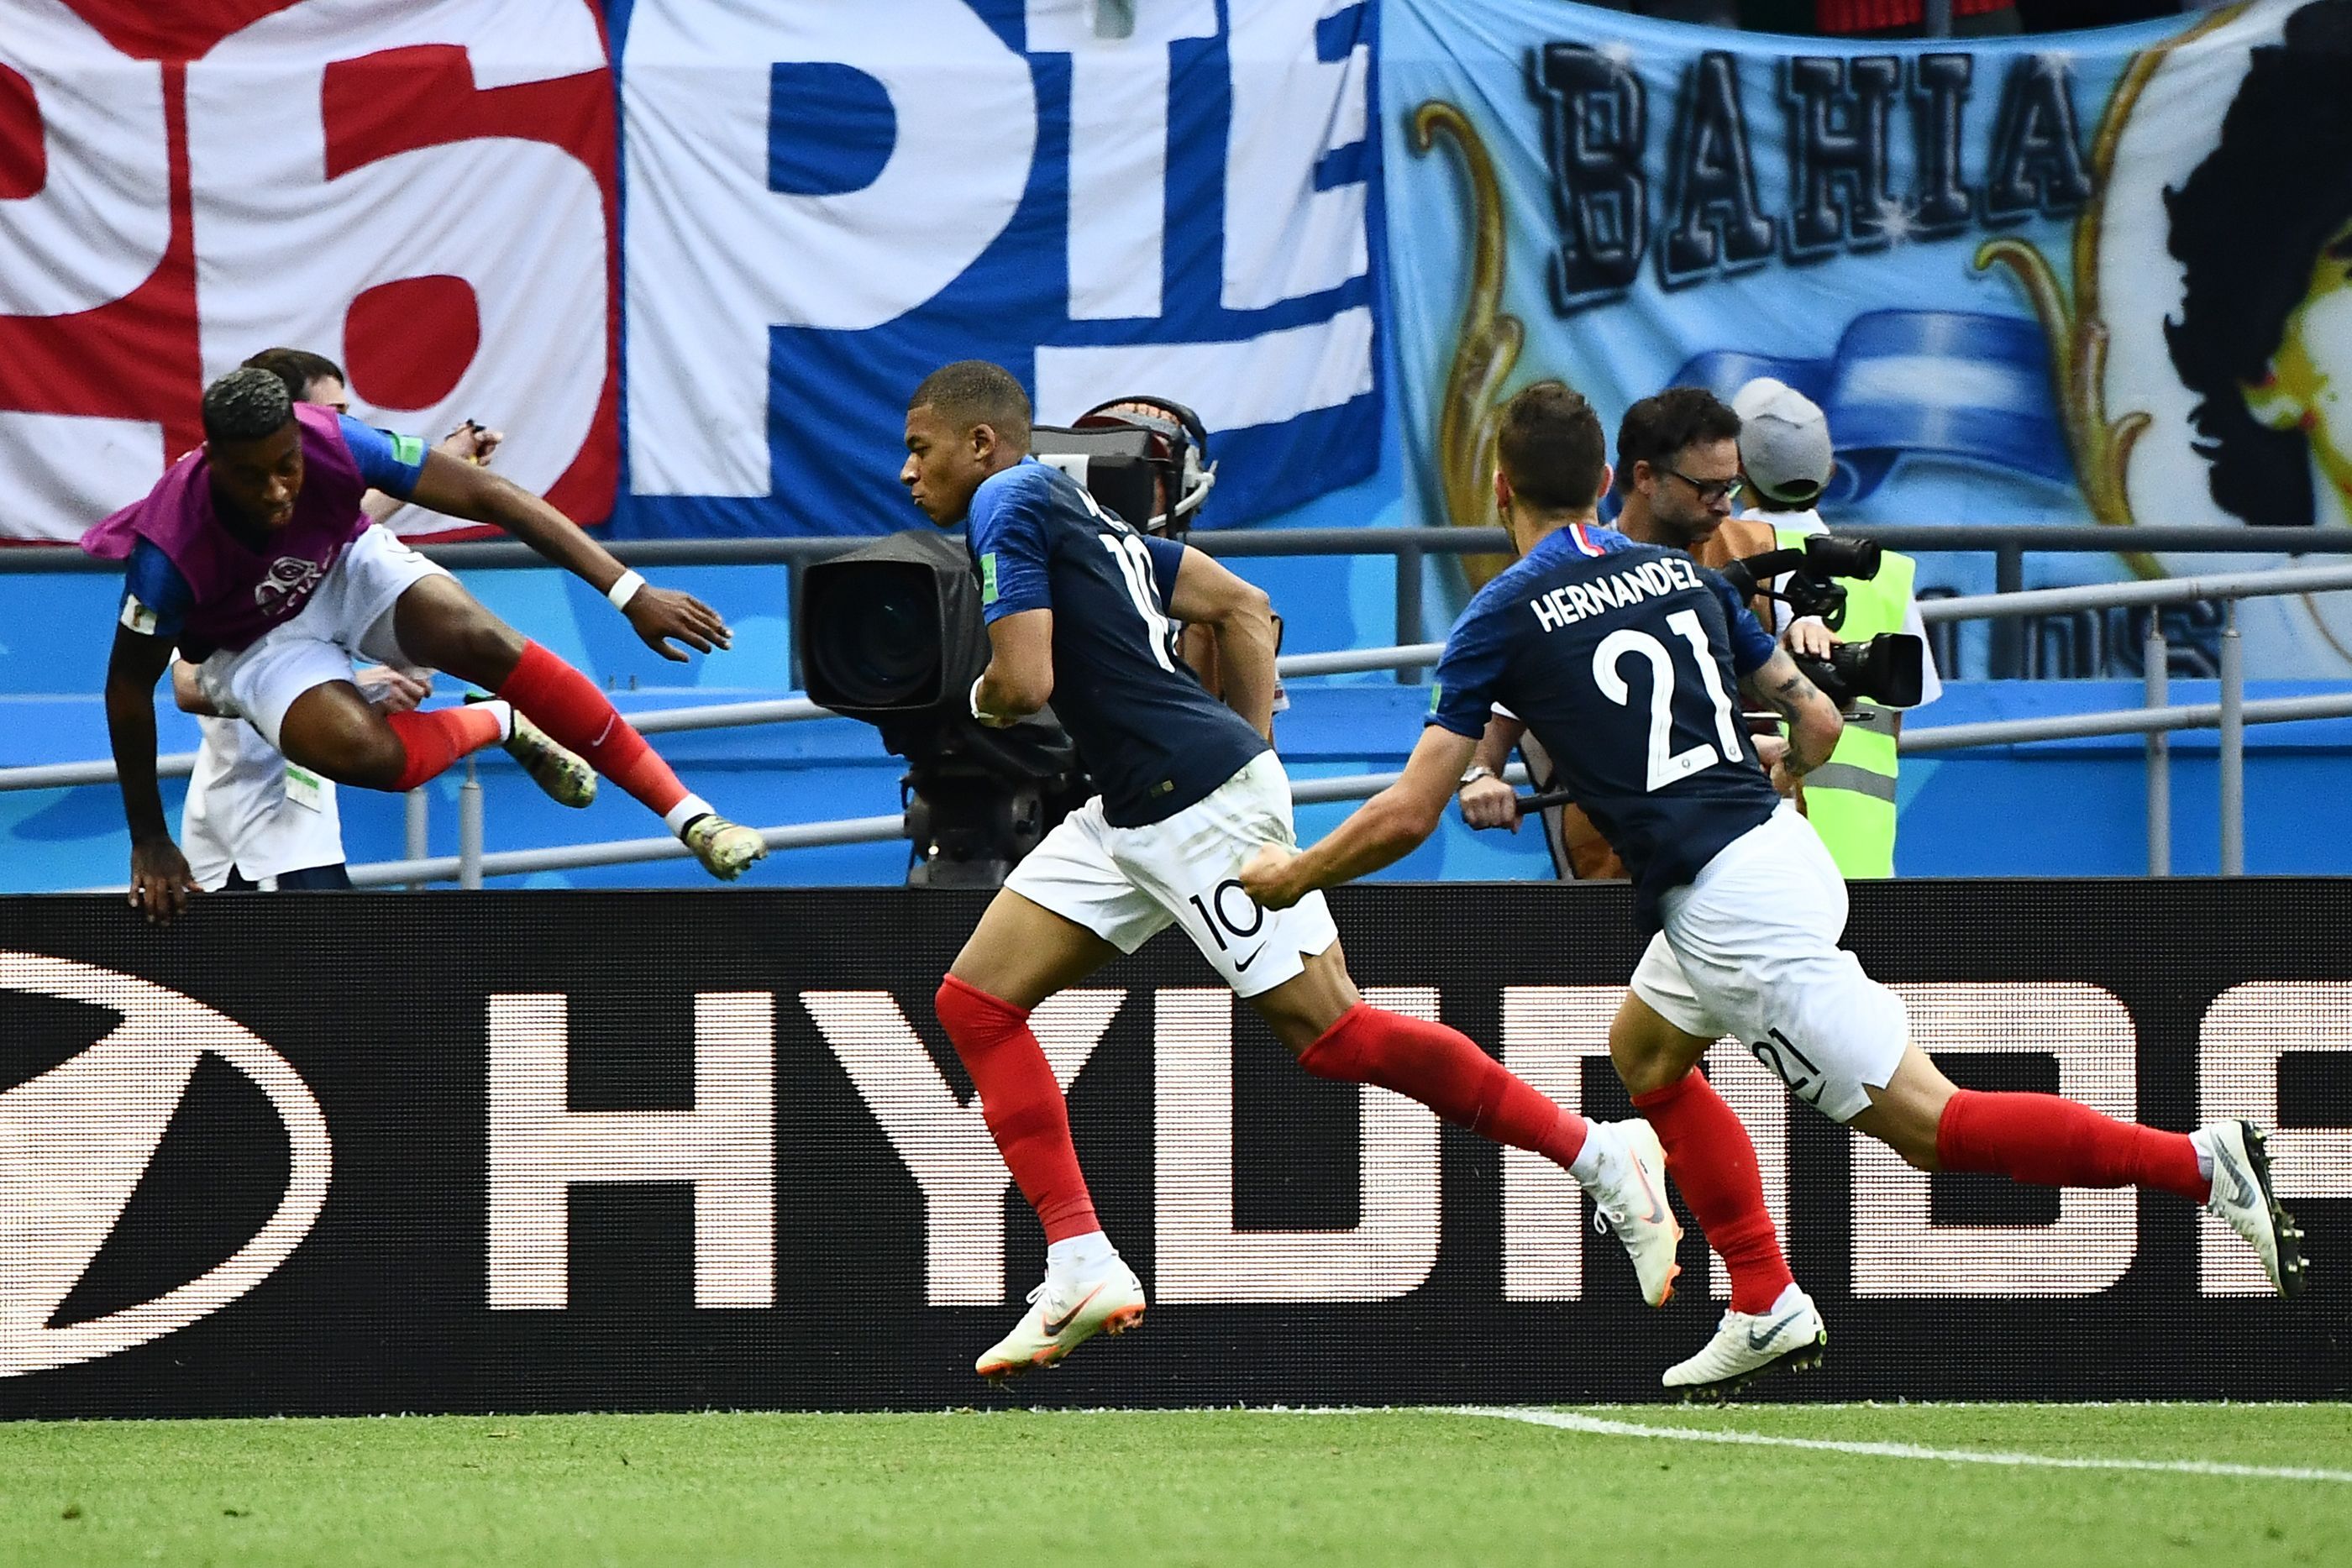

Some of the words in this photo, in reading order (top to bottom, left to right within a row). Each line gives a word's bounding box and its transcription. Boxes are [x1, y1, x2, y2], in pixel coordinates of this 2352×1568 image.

[1525, 40, 2092, 317] BAHIA
[1530, 558, 1704, 633] HERNANDEZ
[1592, 609, 1745, 793] 21
[1189, 878, 1263, 952] 10
[1751, 1026, 1821, 1092] 21
